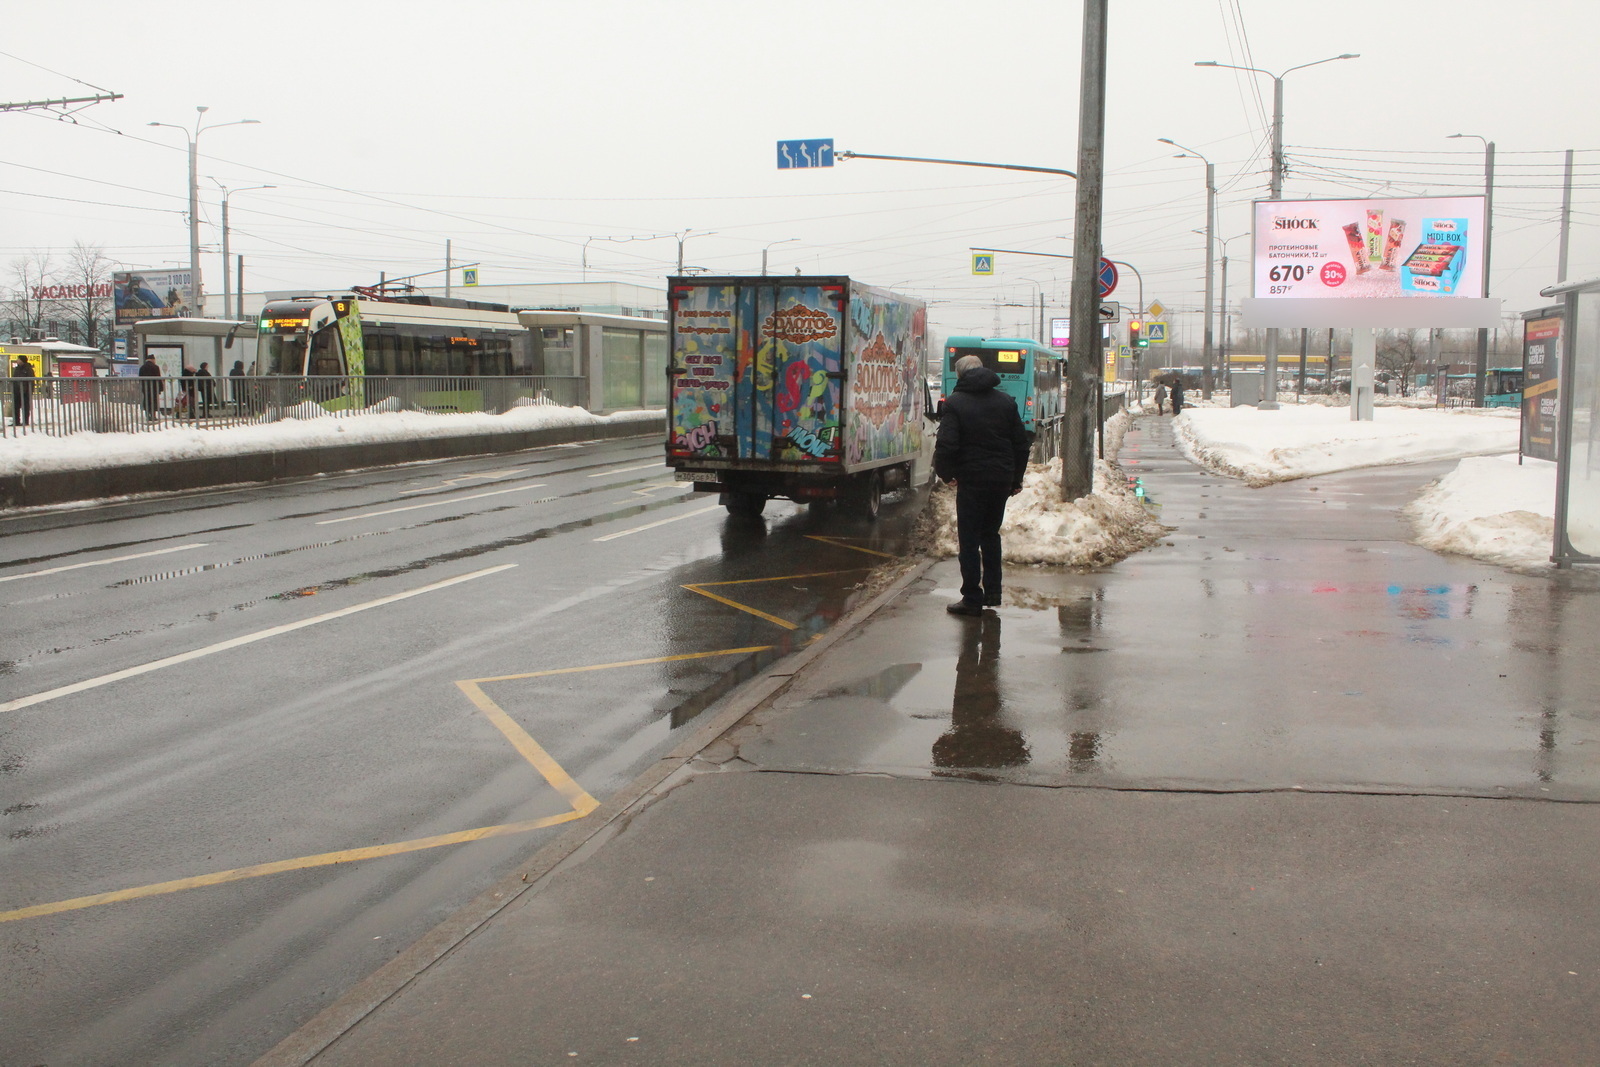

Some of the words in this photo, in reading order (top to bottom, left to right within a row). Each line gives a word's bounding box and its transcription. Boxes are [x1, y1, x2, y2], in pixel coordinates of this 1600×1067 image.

[1274, 219, 1318, 230] SHOCK
[1426, 233, 1444, 242] MIDI
[1446, 233, 1461, 242] BOX
[1324, 269, 1344, 279] 30%
[1414, 279, 1438, 287] SHOCK
[30, 280, 113, 299] ХАСАНСКИЙ
[337, 302, 345, 312] 8
[762, 317, 837, 331] ЗОЛОТОЕ
[1529, 344, 1545, 355] CINEMA
[1528, 355, 1544, 365] MEDLEY
[855, 363, 901, 394] ЗОЛОТОЕ
